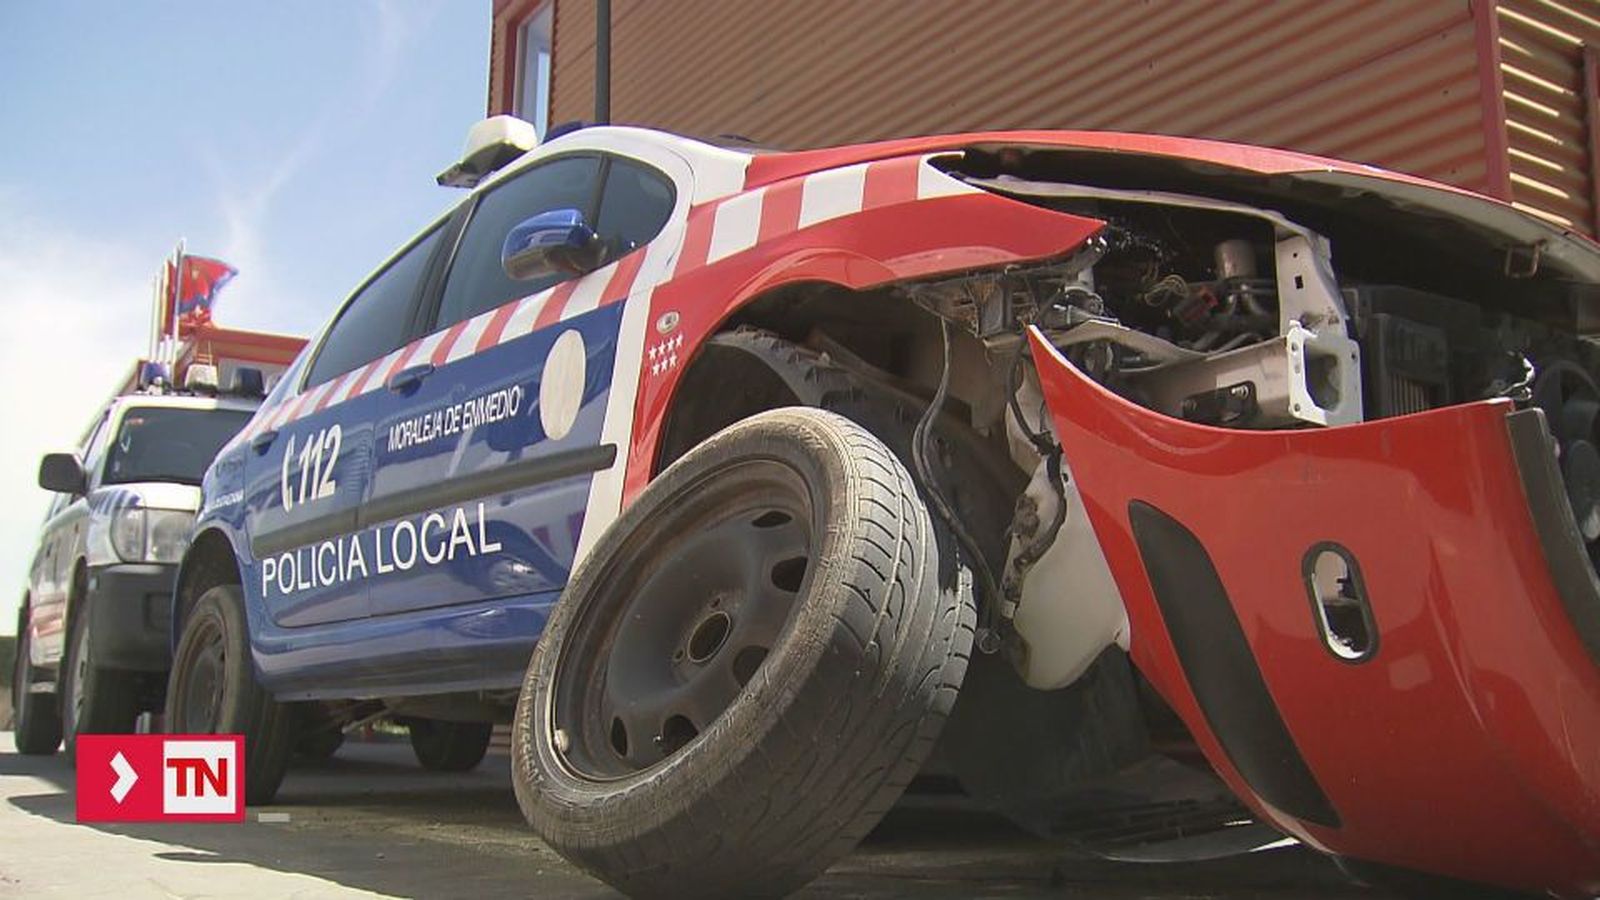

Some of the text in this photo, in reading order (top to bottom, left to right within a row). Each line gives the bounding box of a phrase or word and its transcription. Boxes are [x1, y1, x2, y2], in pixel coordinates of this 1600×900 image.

[388, 385, 521, 452] MORALEJA DE ENMEDIO
[298, 424, 342, 504] 112
[262, 502, 502, 597] POLICIA LOCAL
